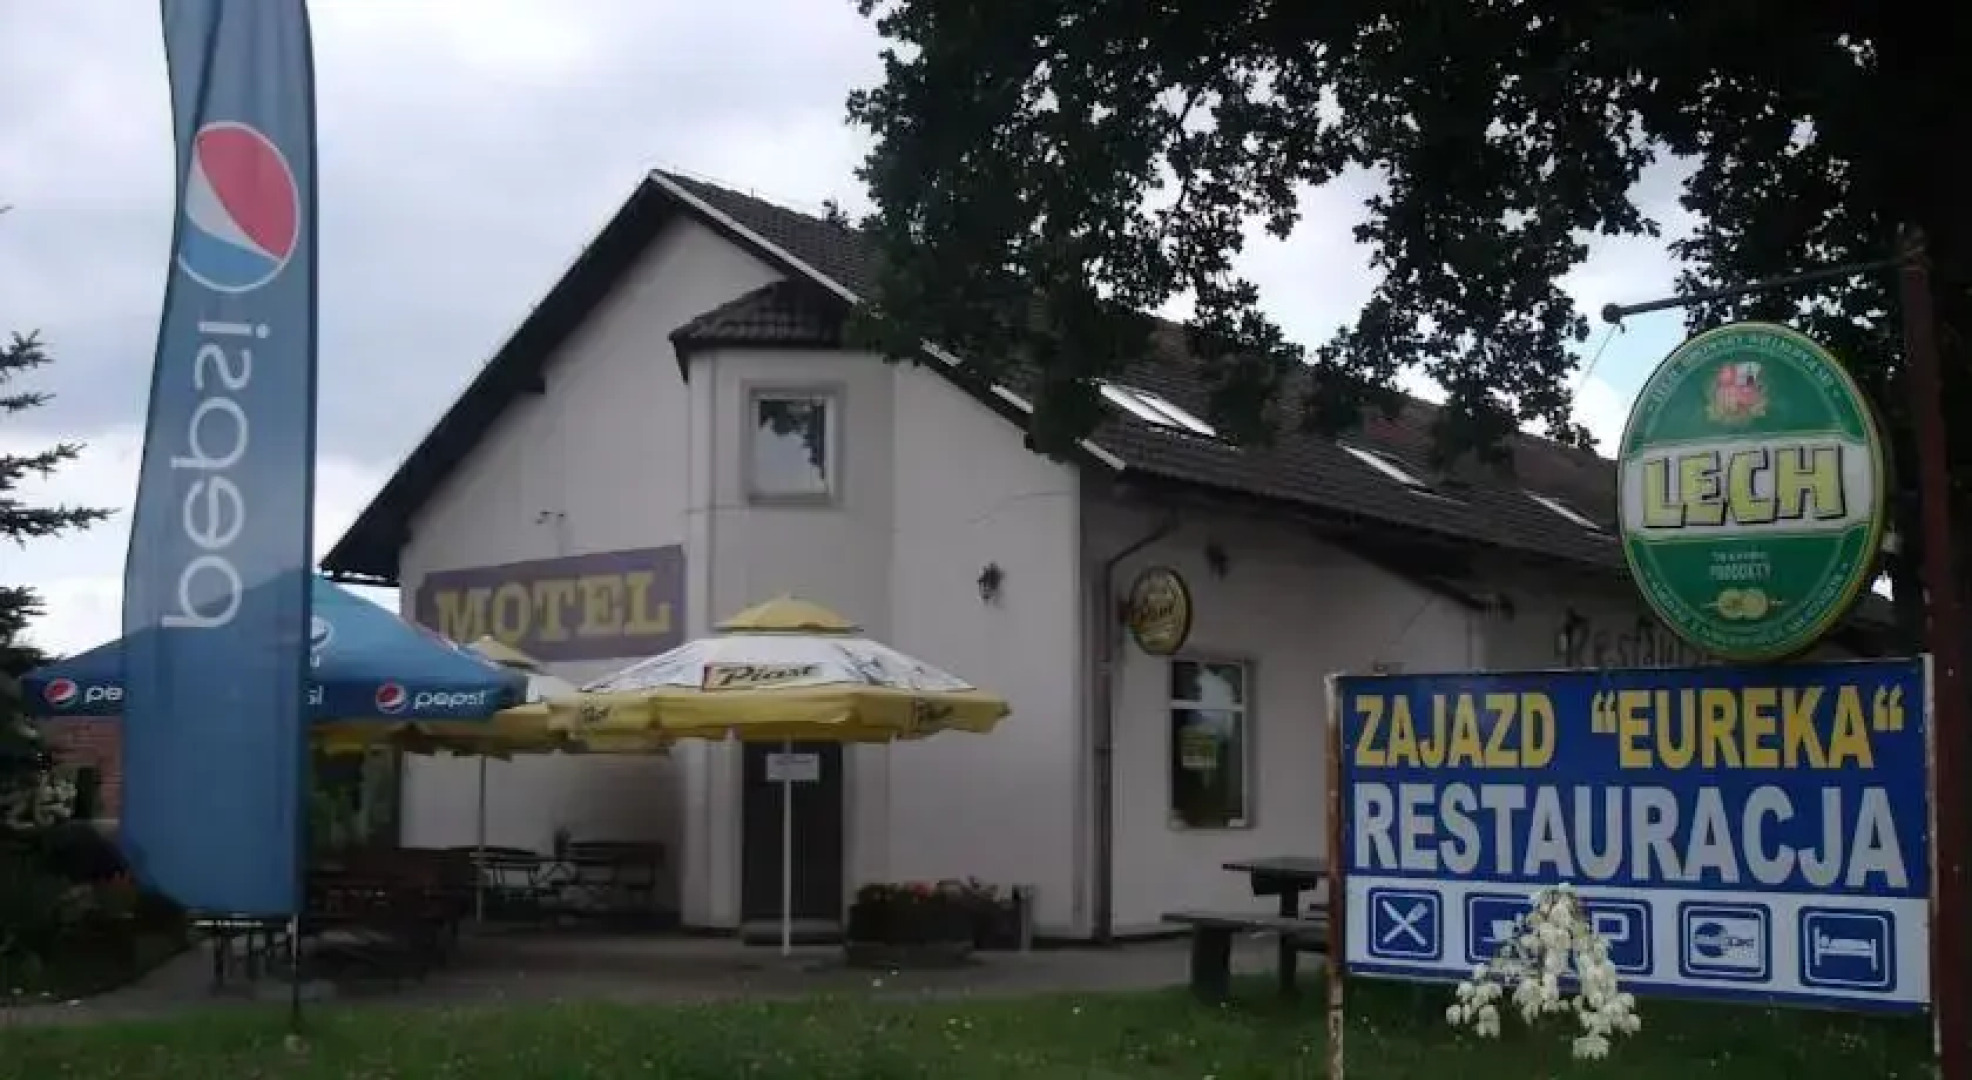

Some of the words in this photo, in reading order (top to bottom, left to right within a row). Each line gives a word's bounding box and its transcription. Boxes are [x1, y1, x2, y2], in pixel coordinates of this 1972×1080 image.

[1643, 445, 1846, 529] LECH
[435, 571, 671, 644] MOTEL
[413, 691, 487, 711] pepsi
[1354, 695, 1556, 769] ZAJAZD
[1353, 783, 1909, 889] RESTAURACJA
